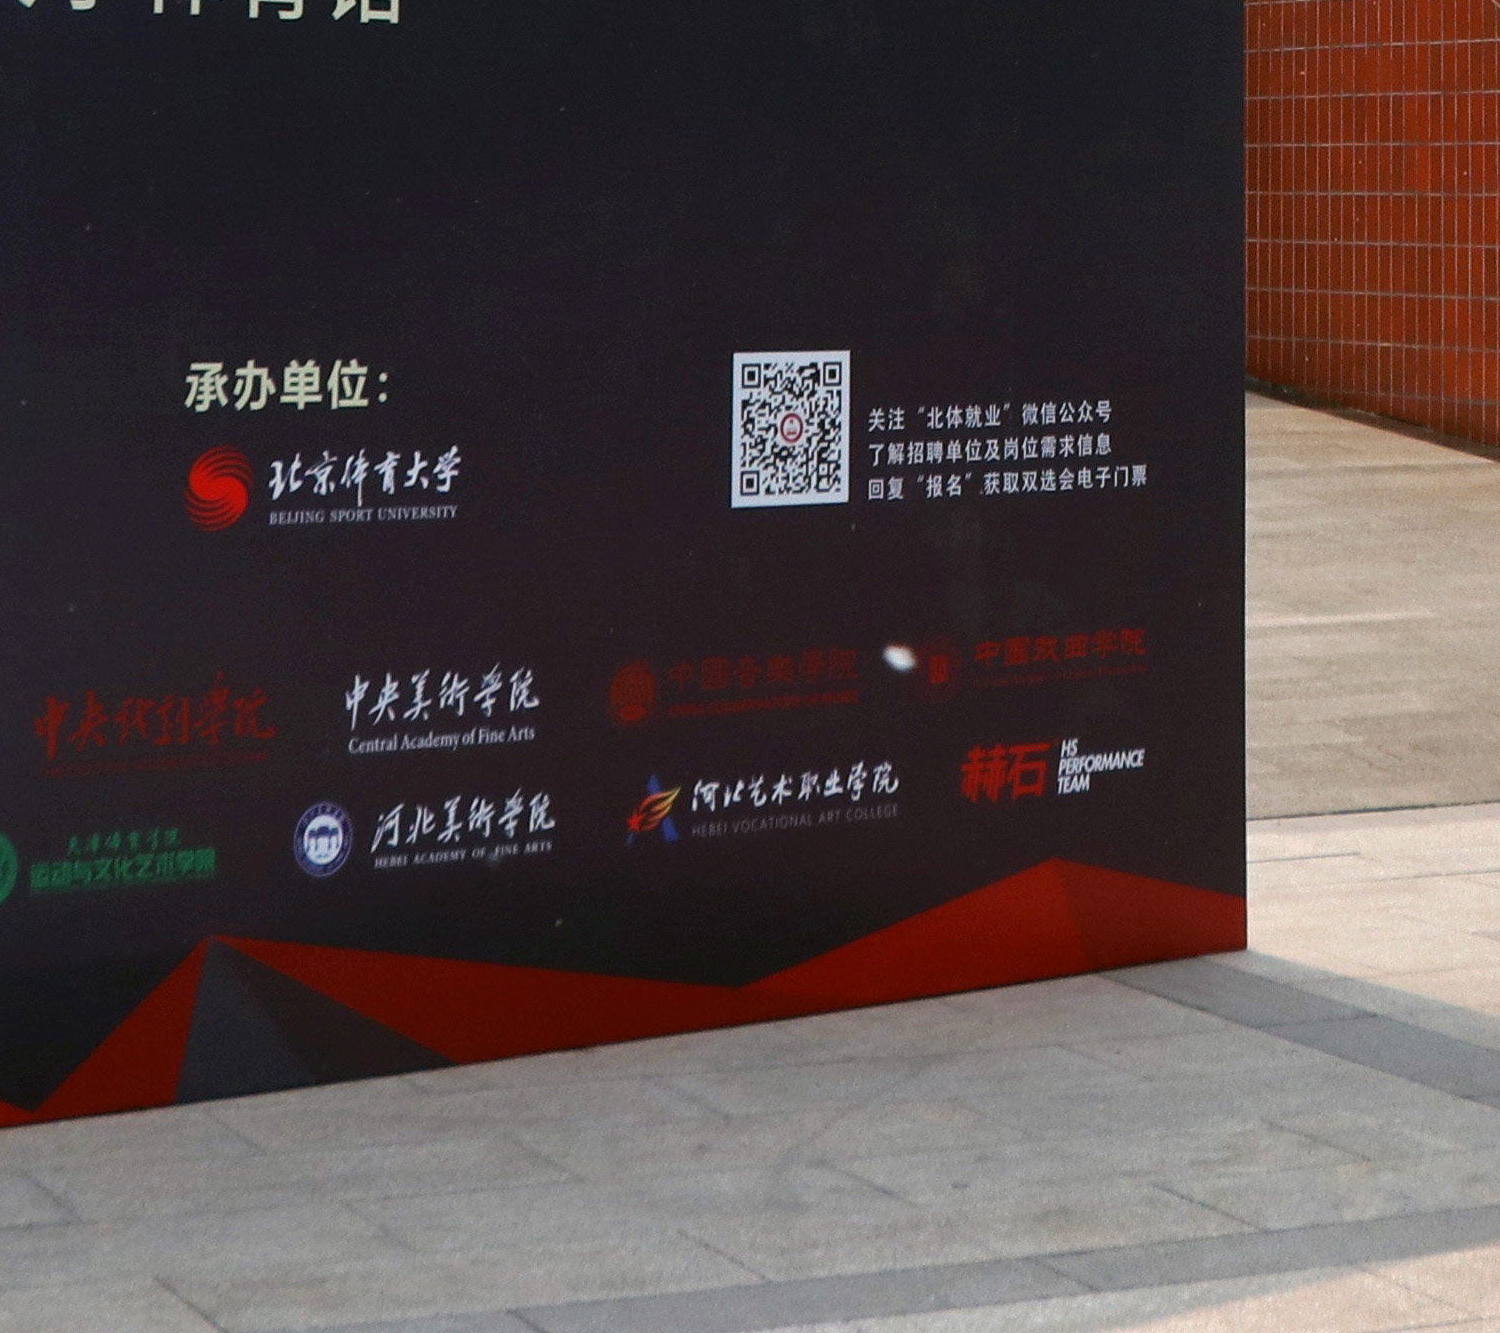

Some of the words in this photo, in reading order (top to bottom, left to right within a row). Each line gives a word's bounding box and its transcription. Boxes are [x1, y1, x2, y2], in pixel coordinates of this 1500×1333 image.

[867, 432, 1112, 467] 了解招聘单位及岗位需求信息
[268, 444, 462, 507] 北京体育大学
[268, 508, 325, 526] BEIJING
[329, 507, 372, 524] SPORT
[377, 505, 459, 522] UNIVERSITY
[348, 733, 398, 755] Central
[400, 729, 460, 753] Academy
[461, 727, 476, 745] of
[477, 726, 506, 745] Fine
[507, 724, 536, 743] Arts
[1060, 738, 1079, 758] HS
[961, 742, 1051, 803] 赫石
[1058, 748, 1146, 777] PERFORMANCE
[1057, 774, 1091, 795] TEAM
[691, 824, 728, 838] HEBEI
[732, 813, 813, 834] VOCATIONAL
[818, 809, 842, 823] ART
[846, 803, 899, 821] COLLEGE
